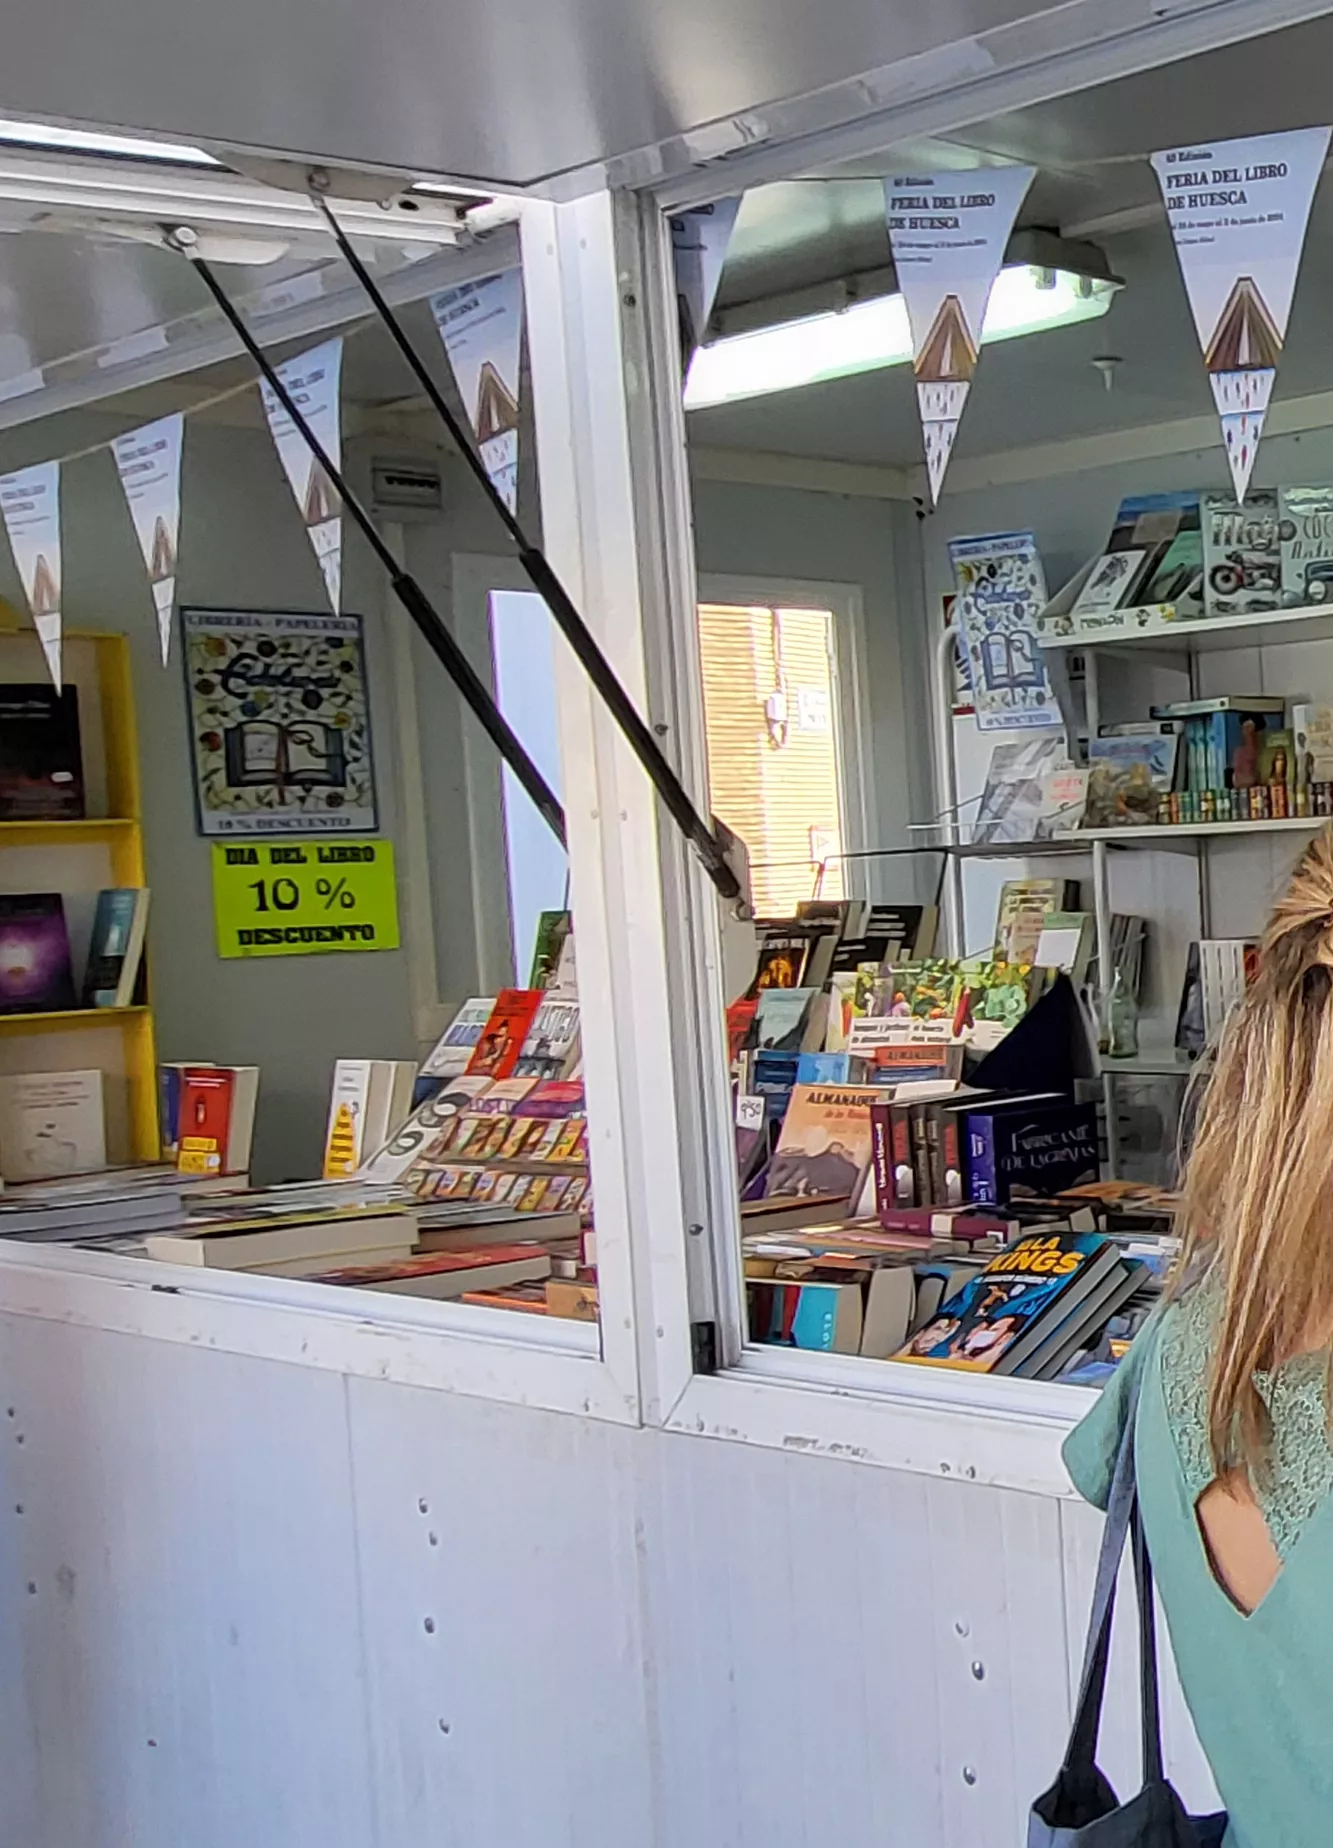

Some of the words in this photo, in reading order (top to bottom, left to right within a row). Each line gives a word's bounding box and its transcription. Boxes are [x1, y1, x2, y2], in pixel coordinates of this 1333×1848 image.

[1167, 171, 1208, 189] FERIA
[1212, 169, 1242, 184] DEL
[1245, 163, 1287, 181] LIBRO
[1167, 196, 1185, 210] DE
[1187, 190, 1247, 208] HUESCA
[226, 847, 258, 866] DIA
[270, 847, 306, 865] DEL
[318, 847, 375, 863] LIBRO
[249, 878, 299, 912] 10
[316, 877, 355, 910] %
[238, 925, 375, 946] DESCUENTO
[984, 1250, 1086, 1275] KINGS
